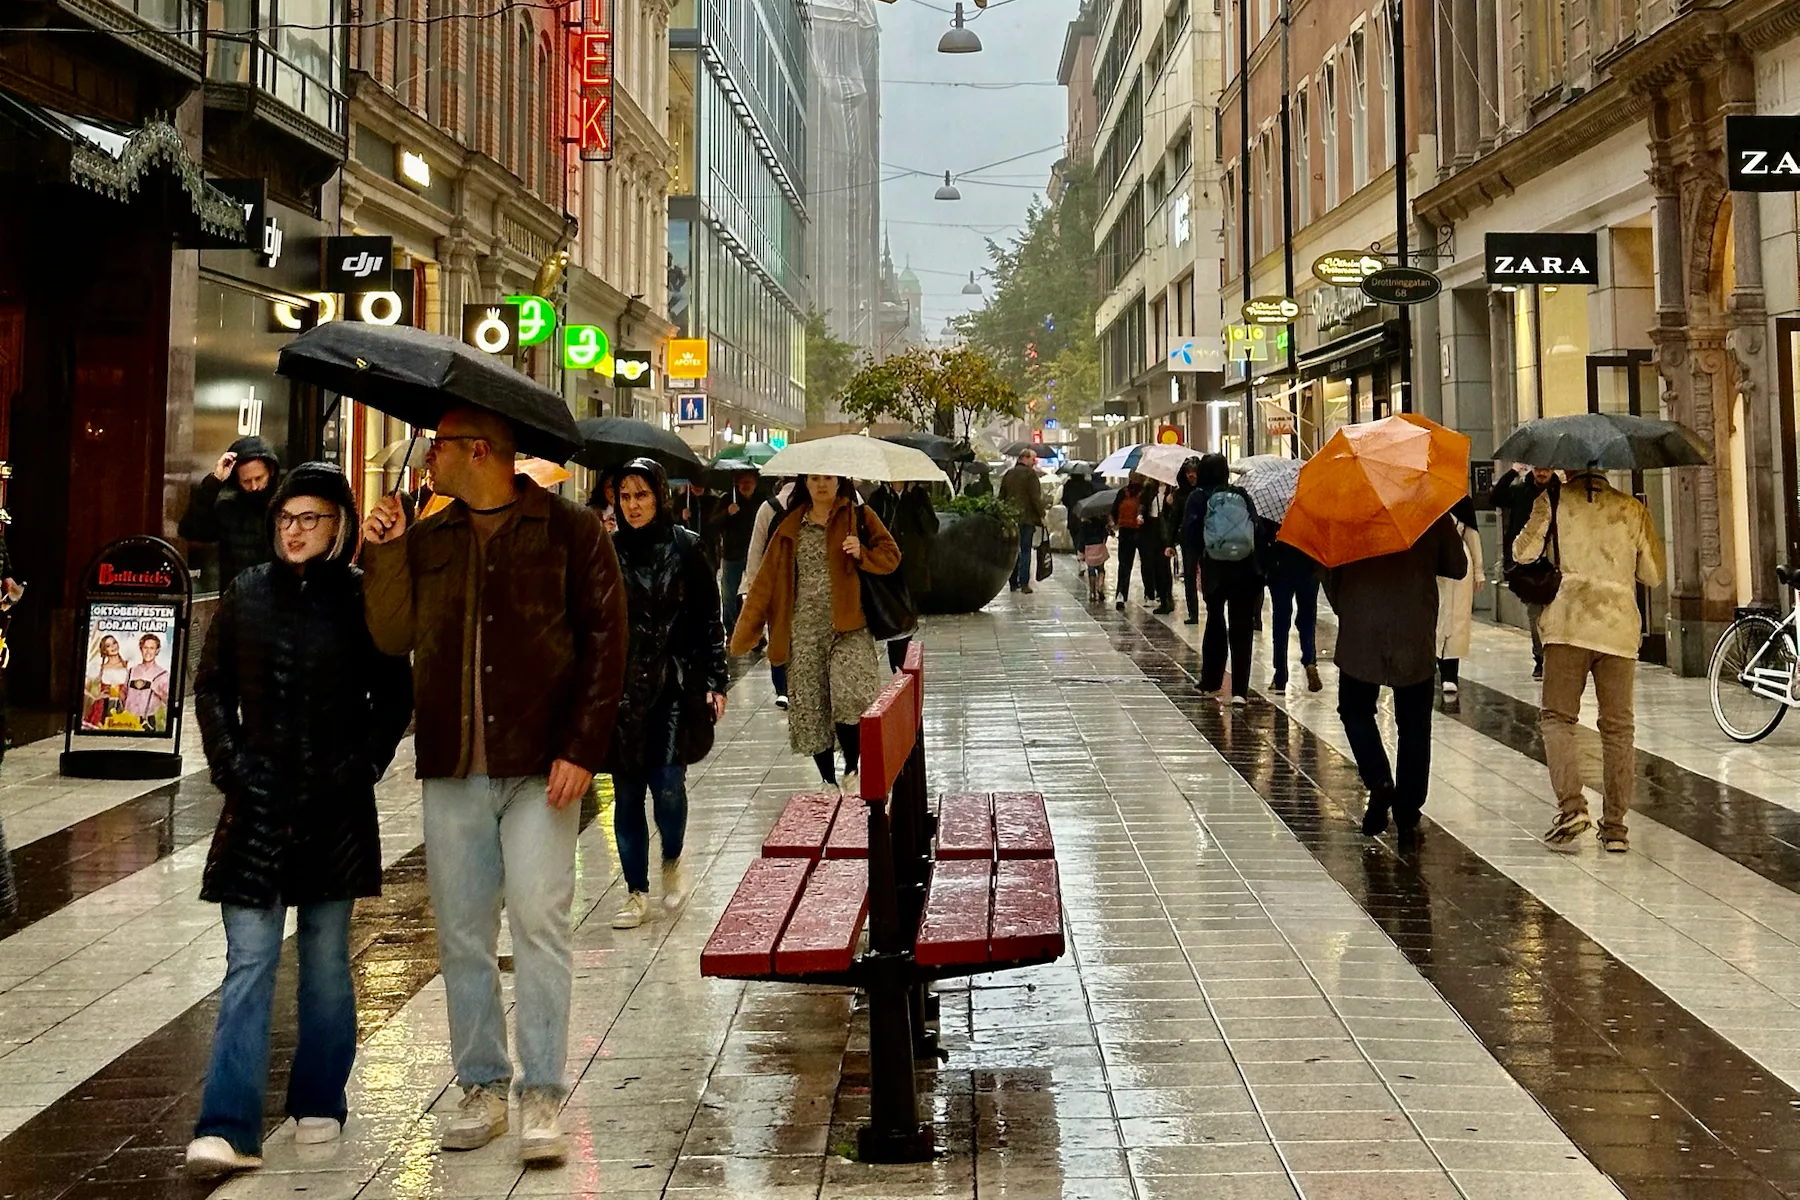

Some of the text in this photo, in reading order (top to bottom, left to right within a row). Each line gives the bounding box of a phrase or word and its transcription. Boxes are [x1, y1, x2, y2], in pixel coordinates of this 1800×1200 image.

[1494, 256, 1590, 274] ZARA
[1371, 278, 1431, 288] Drottninggatan
[1395, 288, 1407, 297] 68
[93, 606, 174, 617] OKTOBERFESTEN
